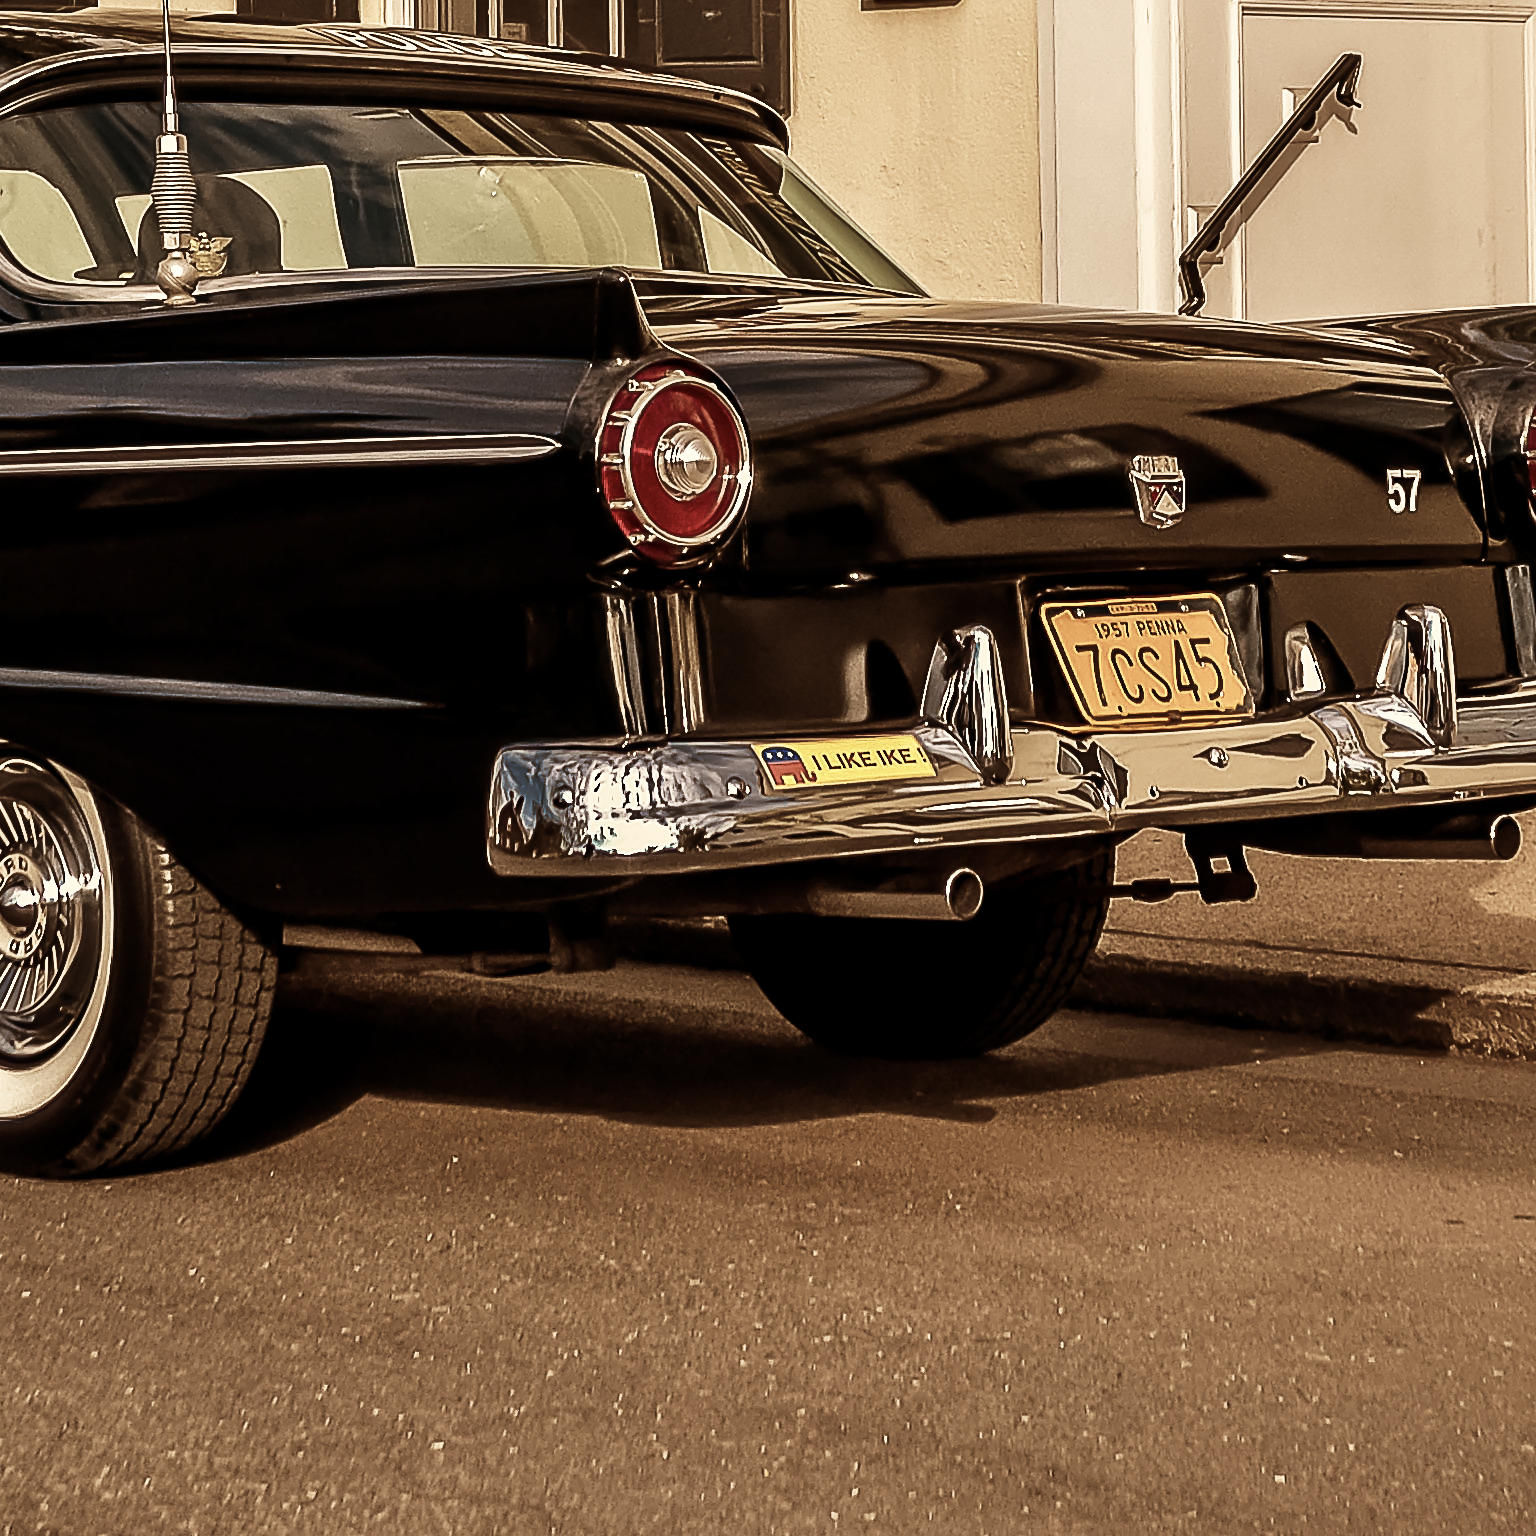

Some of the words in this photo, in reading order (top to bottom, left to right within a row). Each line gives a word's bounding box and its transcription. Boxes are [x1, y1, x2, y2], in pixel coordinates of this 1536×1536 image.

[1386, 468, 1422, 514] 57
[1093, 621, 1130, 640] 1957
[1135, 619, 1188, 637] PENNA
[1074, 637, 1224, 707] 7CS45
[811, 754, 822, 771] I
[822, 751, 877, 770] LIKE
